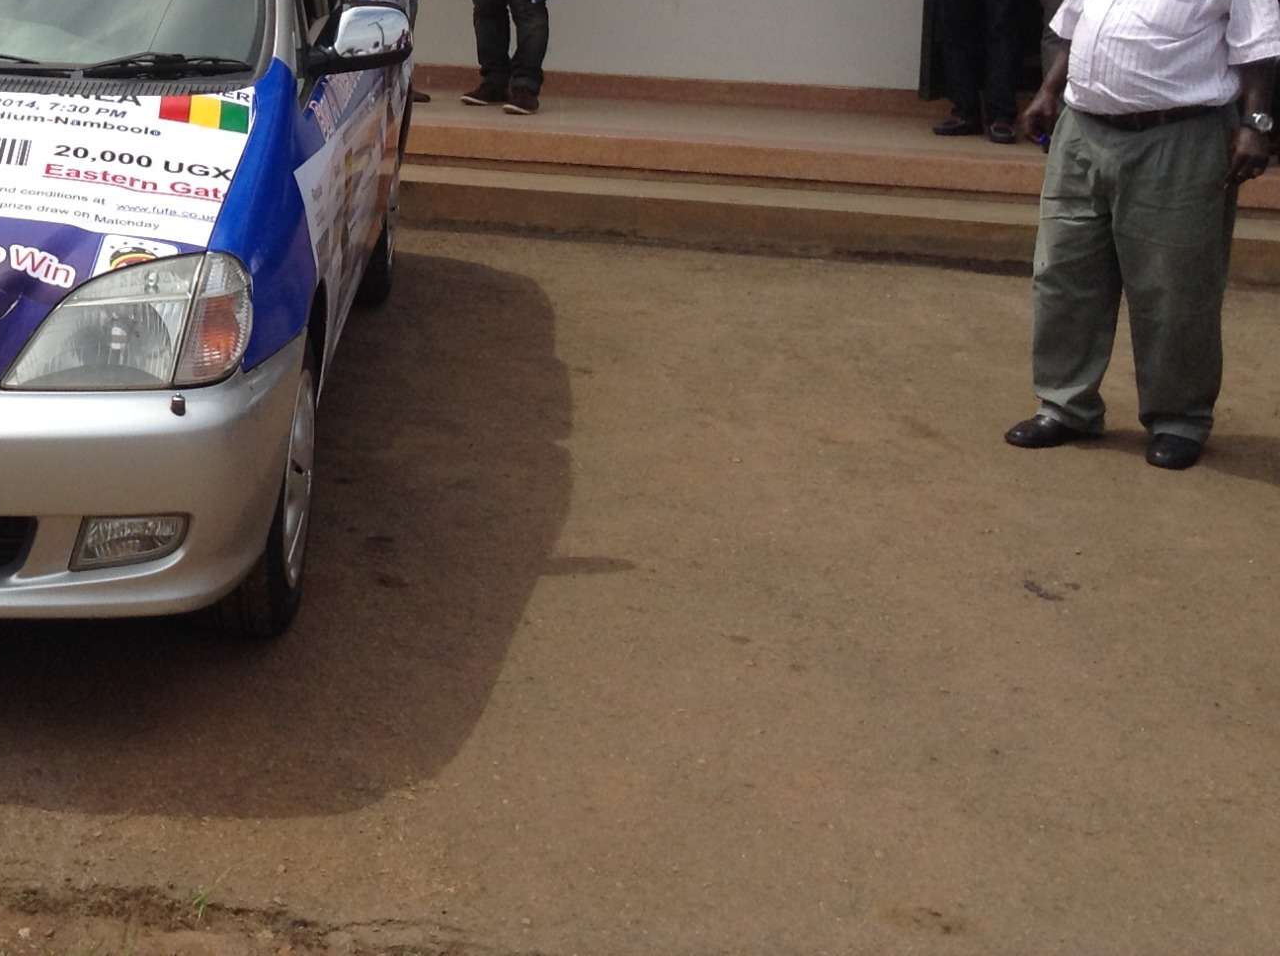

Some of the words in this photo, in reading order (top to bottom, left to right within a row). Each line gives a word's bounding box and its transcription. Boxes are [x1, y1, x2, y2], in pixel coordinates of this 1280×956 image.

[49, 102, 90, 115] 7:30
[95, 107, 128, 119] PM
[53, 144, 153, 168] 20,000
[163, 159, 233, 182] UGX
[44, 163, 159, 191] Eastern
[169, 181, 227, 201] Gat
[0, 201, 33, 212] prize
[36, 204, 70, 216] draw
[73, 209, 91, 220] on
[19, 188, 89, 203] conditions
[92, 196, 107, 206] at
[13, 246, 73, 286] Win
